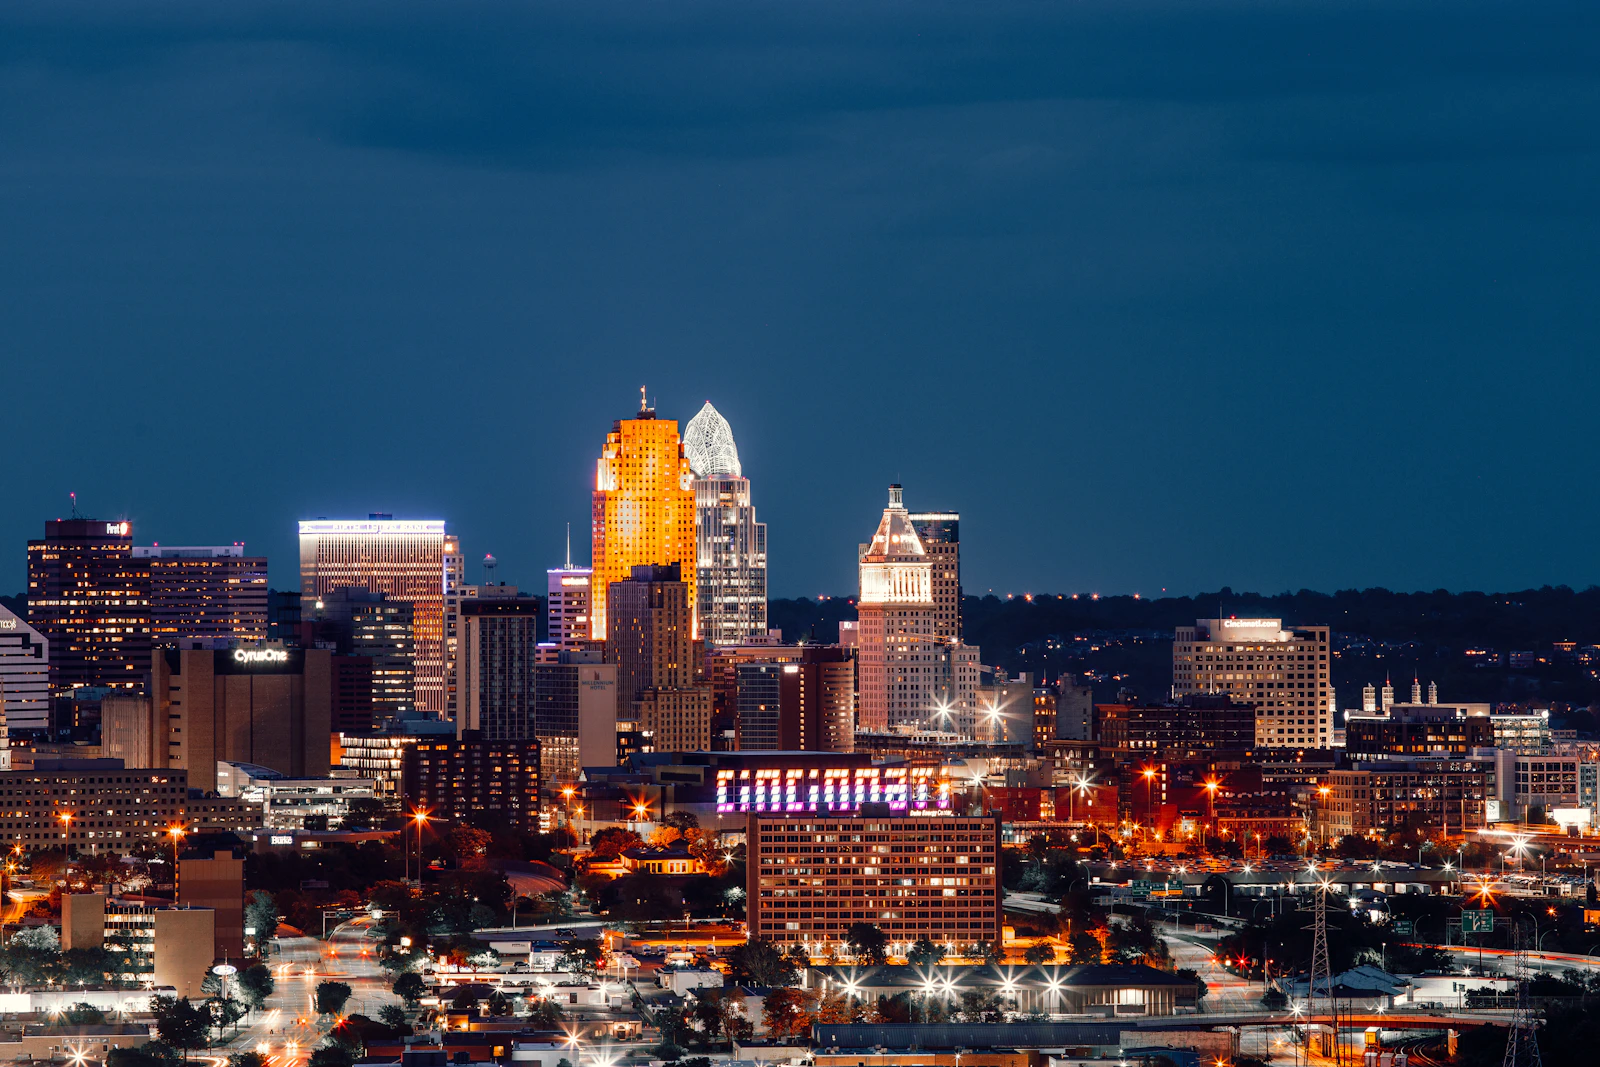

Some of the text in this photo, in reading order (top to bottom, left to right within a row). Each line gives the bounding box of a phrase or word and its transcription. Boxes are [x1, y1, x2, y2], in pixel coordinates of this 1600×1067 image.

[1224, 619, 1278, 628] Cincinnati.com
[234, 649, 288, 664] CyrusOne
[271, 836, 293, 845] Burke
